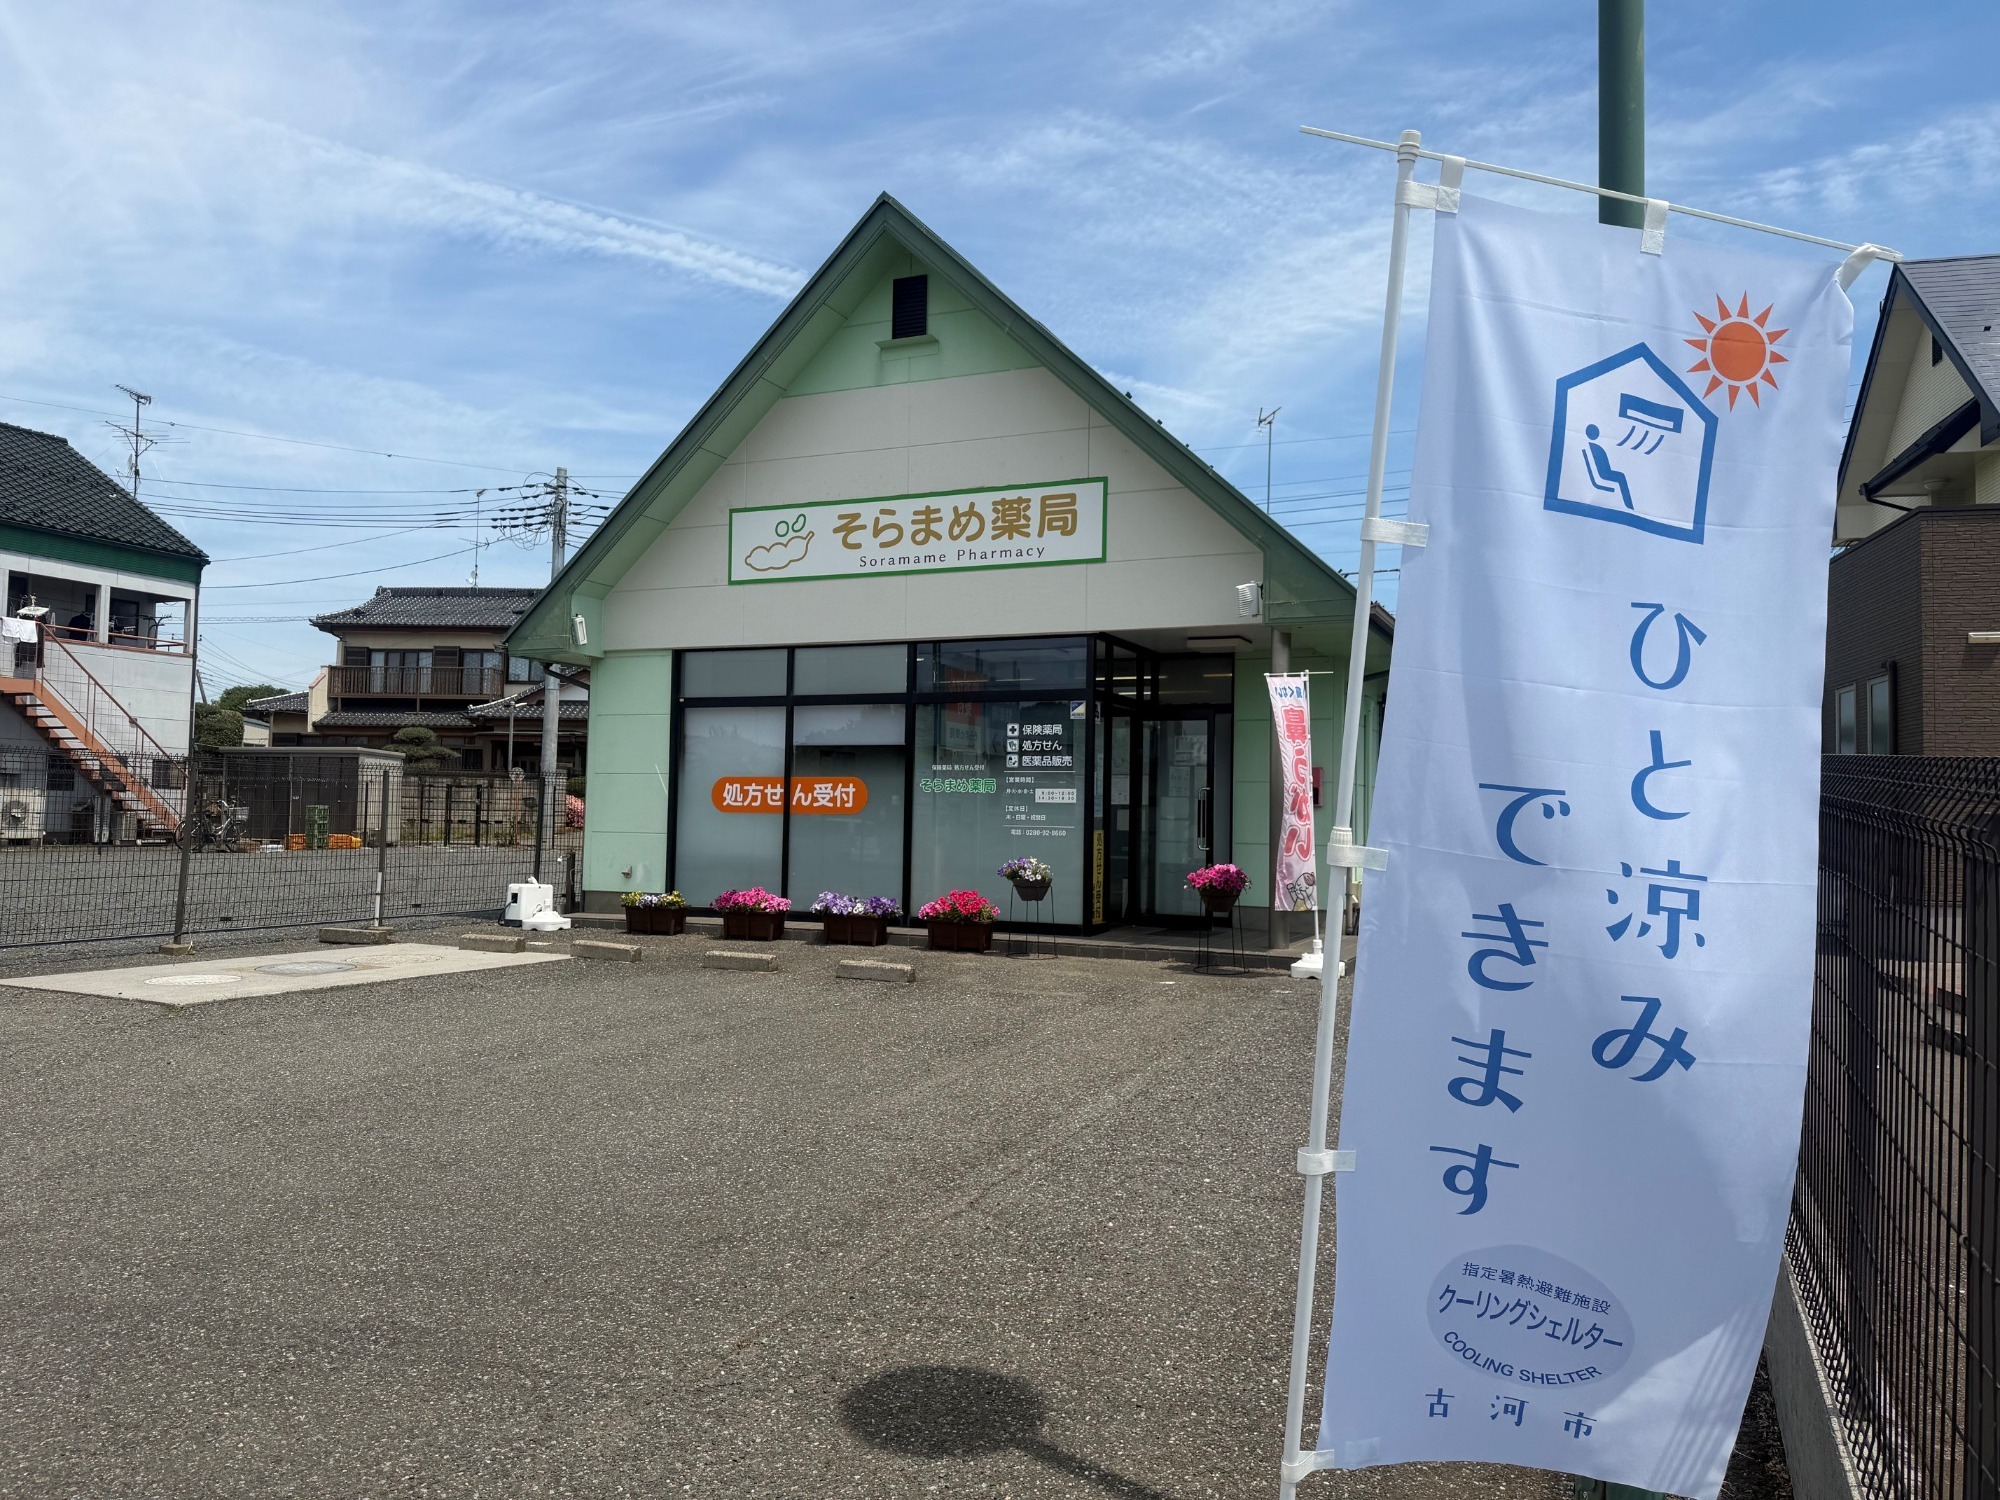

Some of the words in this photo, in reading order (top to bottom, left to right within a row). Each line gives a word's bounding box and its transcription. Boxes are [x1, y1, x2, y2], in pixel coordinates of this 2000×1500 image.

[832, 492, 1077, 550] そらまめ薬局
[859, 552, 947, 567] Soramame
[957, 546, 1046, 561] Pharmacy
[1021, 740, 1063, 751] 処方せん
[1022, 724, 1063, 735] 保険薬局
[1021, 755, 1073, 767] 医薬品販売
[722, 782, 856, 808] 処方せん受付
[919, 778, 997, 793] そらまめ薬局
[1591, 602, 1708, 1083] ひと涼み
[1429, 782, 1571, 1216] できます
[1462, 1261, 1612, 1316] 指定暑熱避難施設
[1438, 1284, 1623, 1350] クーリングシェルター
[1443, 1331, 1515, 1377] COOLING
[1518, 1365, 1602, 1385] SHELTER
